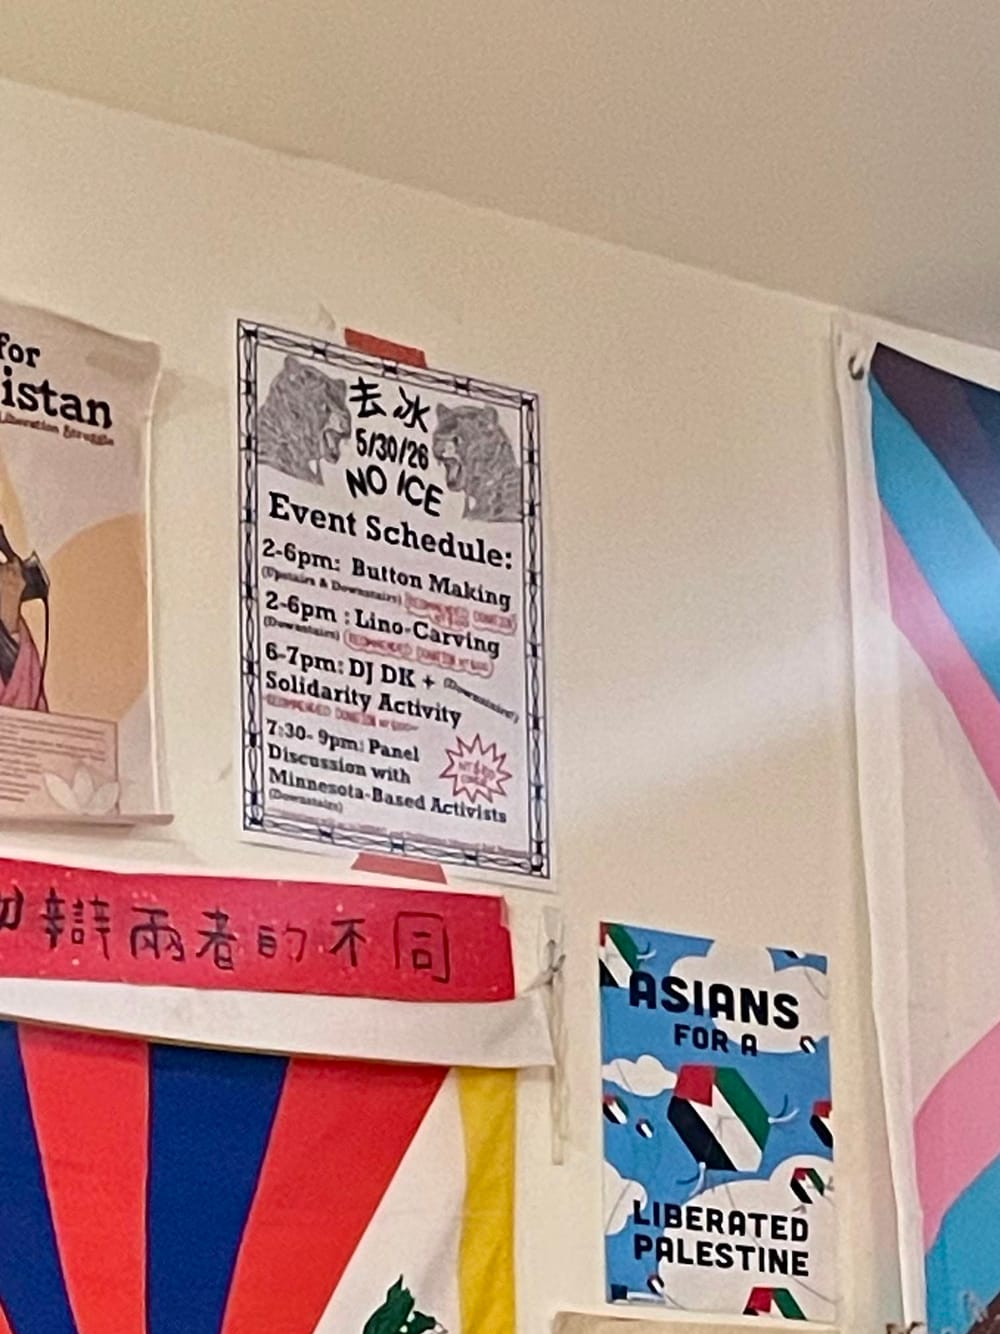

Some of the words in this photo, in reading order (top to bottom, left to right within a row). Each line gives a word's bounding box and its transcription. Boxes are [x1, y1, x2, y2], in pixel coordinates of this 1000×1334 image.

[349, 376, 430, 433] 去冰
[356, 428, 429, 471] 5/30/26
[345, 464, 388, 498] NO
[397, 470, 443, 517] ICE
[268, 491, 357, 537] Event
[366, 515, 512, 570] Schedule:
[262, 538, 341, 573] 2-6pm:
[352, 557, 422, 591] Button
[429, 574, 511, 613] Making
[355, 608, 500, 659] Lino-Carving
[265, 642, 344, 675] 6-7pm:
[349, 658, 375, 685] DJ
[381, 664, 416, 688] DK
[266, 671, 371, 713] Solidarity
[378, 693, 462, 729] Activity
[267, 742, 366, 777] Discussion
[371, 765, 411, 785] with
[369, 738, 419, 763] Panel
[268, 766, 426, 811] Minnesota-Based
[430, 796, 508, 823] Activists
[629, 970, 799, 1030] ASIANS
[674, 1023, 728, 1053] FOR
[741, 1033, 758, 1057] A
[633, 1199, 809, 1243] LIBERATED
[633, 1234, 810, 1278] PALESTINE
